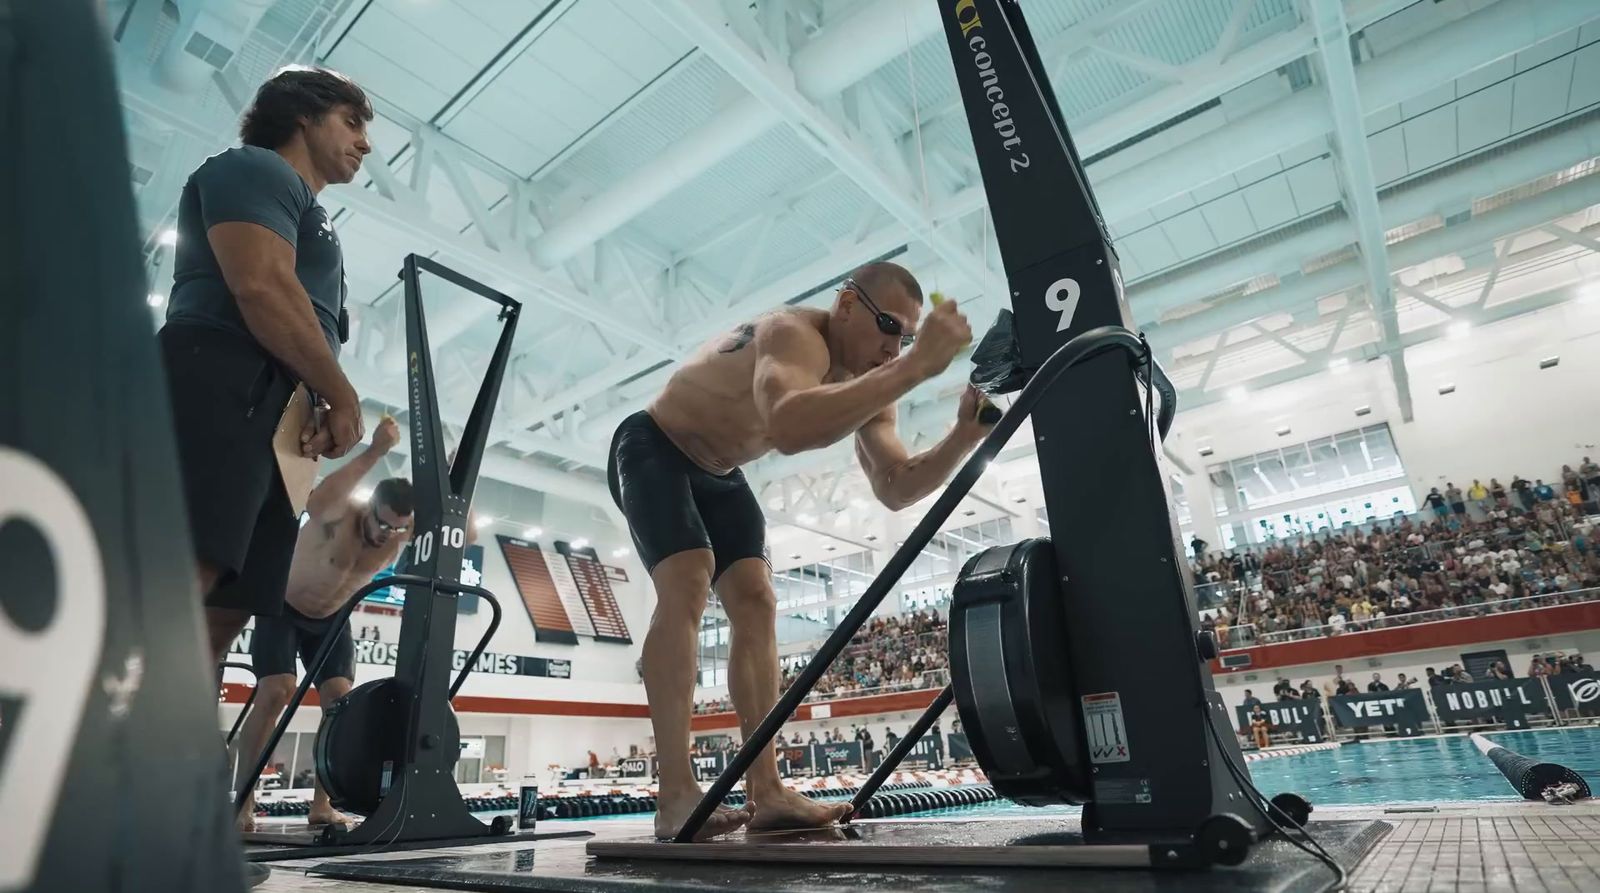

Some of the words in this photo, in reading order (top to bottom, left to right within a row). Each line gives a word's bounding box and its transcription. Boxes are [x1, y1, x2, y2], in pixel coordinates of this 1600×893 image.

[968, 35, 1022, 151] concept
[1010, 152, 1030, 173] 2
[1045, 278, 1080, 332] 9
[412, 378, 425, 451] concept
[414, 531, 434, 565] 10
[441, 525, 464, 548] 10
